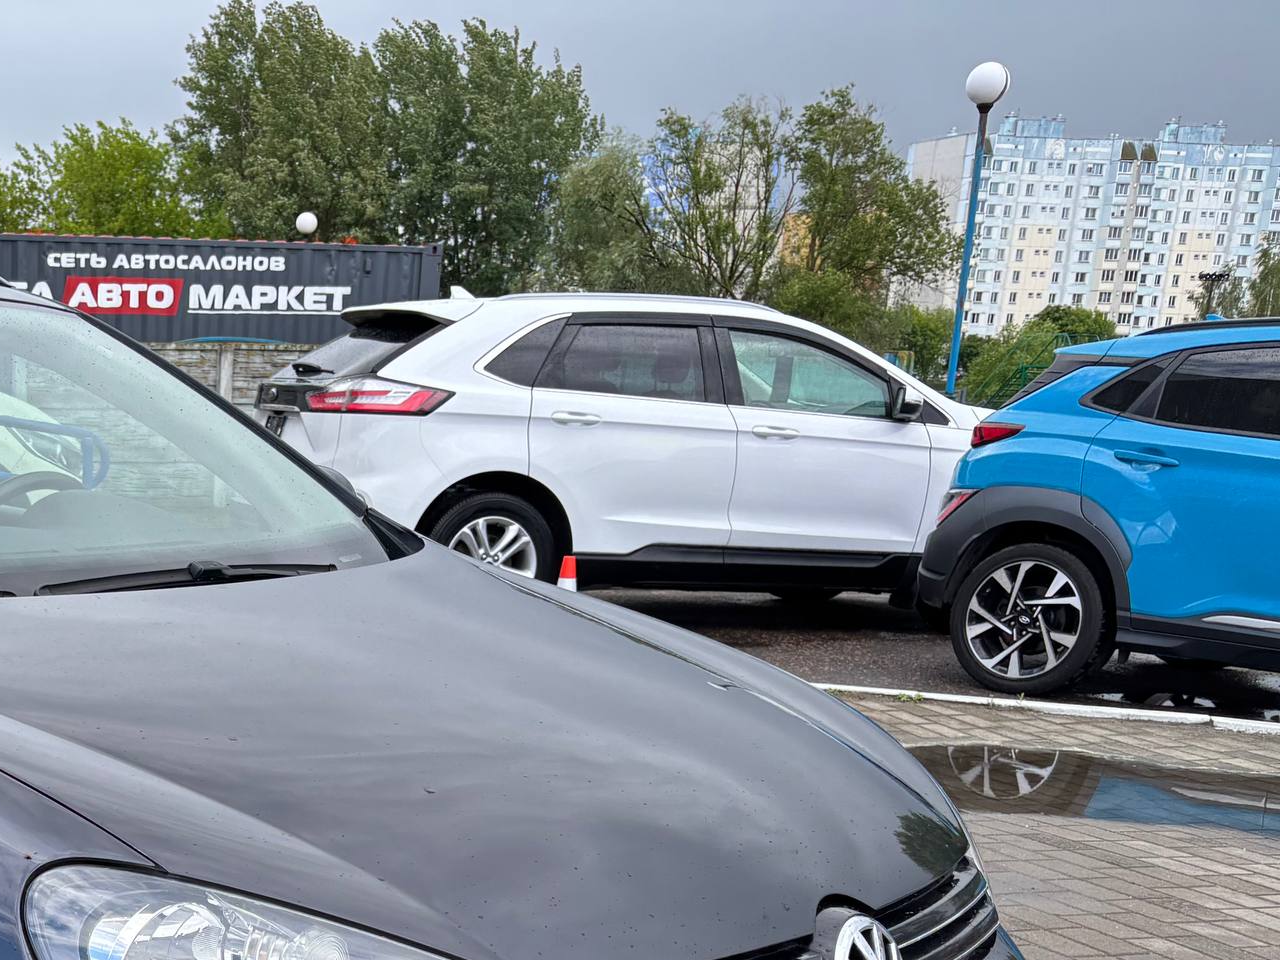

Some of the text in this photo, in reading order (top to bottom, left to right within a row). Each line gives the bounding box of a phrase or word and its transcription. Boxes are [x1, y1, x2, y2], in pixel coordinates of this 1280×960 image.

[46, 253, 286, 272] СЕТЬ АВТОСАЛОНОВ
[67, 282, 175, 310] АВТО
[188, 284, 352, 311] МАРКЕТ
